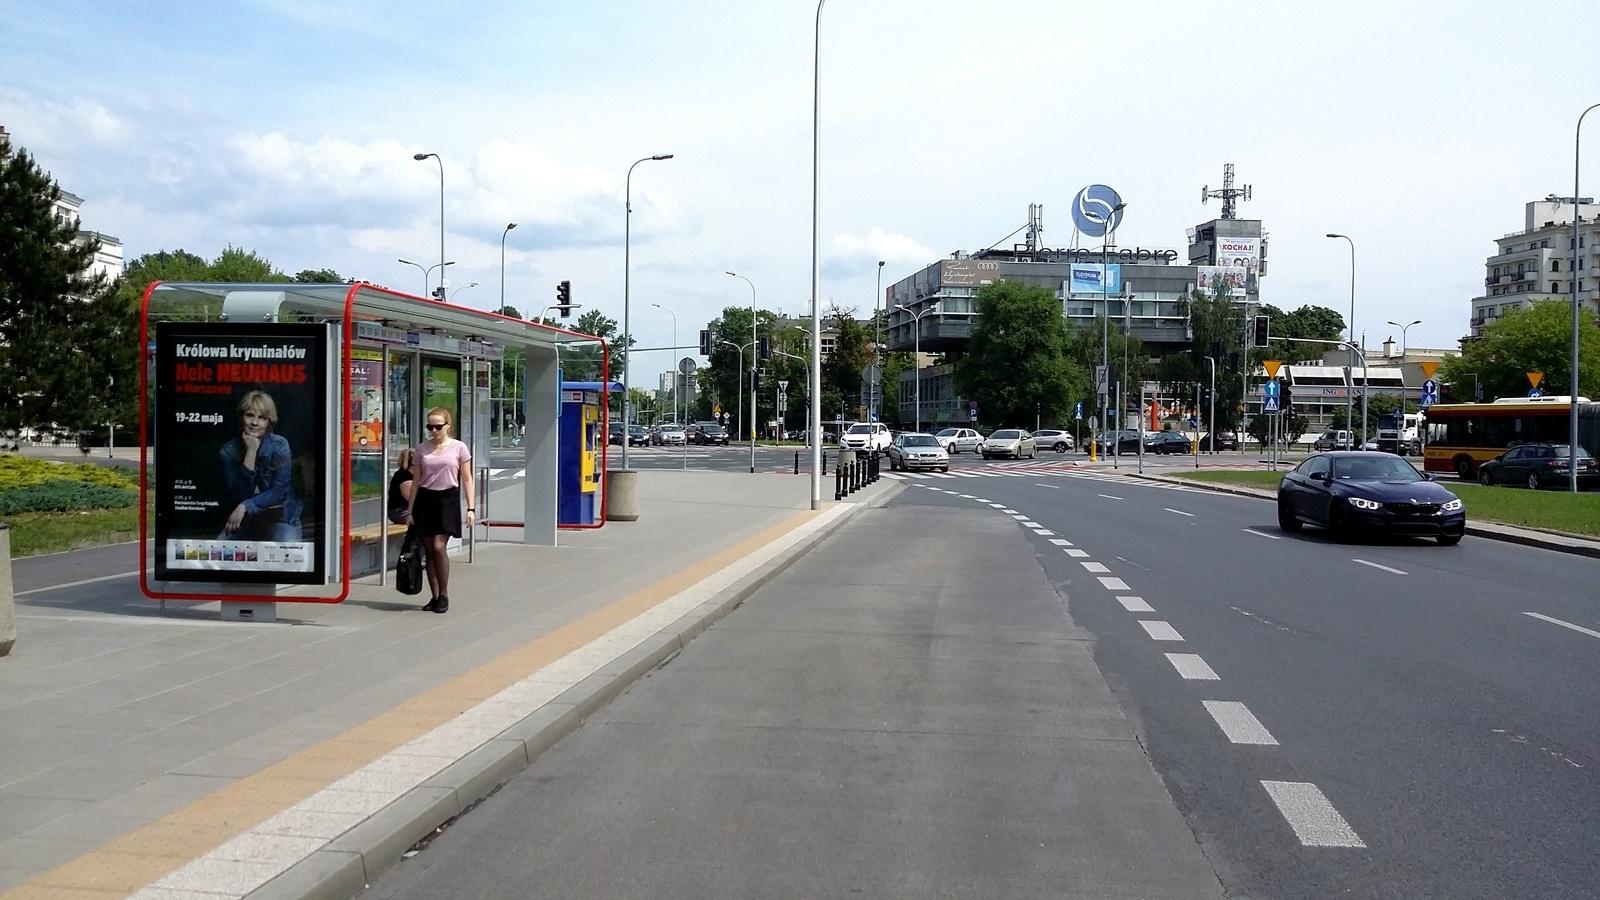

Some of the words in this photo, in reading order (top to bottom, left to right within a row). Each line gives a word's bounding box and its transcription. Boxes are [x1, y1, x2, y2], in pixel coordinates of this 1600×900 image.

[1013, 244, 1090, 260] Pierre
[1103, 245, 1178, 261] Fabre
[176, 344, 228, 358] Królowa
[230, 344, 306, 361] kryminałów
[175, 363, 213, 382] Nele
[216, 363, 306, 384] NEUHAUS
[175, 412, 200, 423] 19-22
[201, 413, 224, 425] maja
